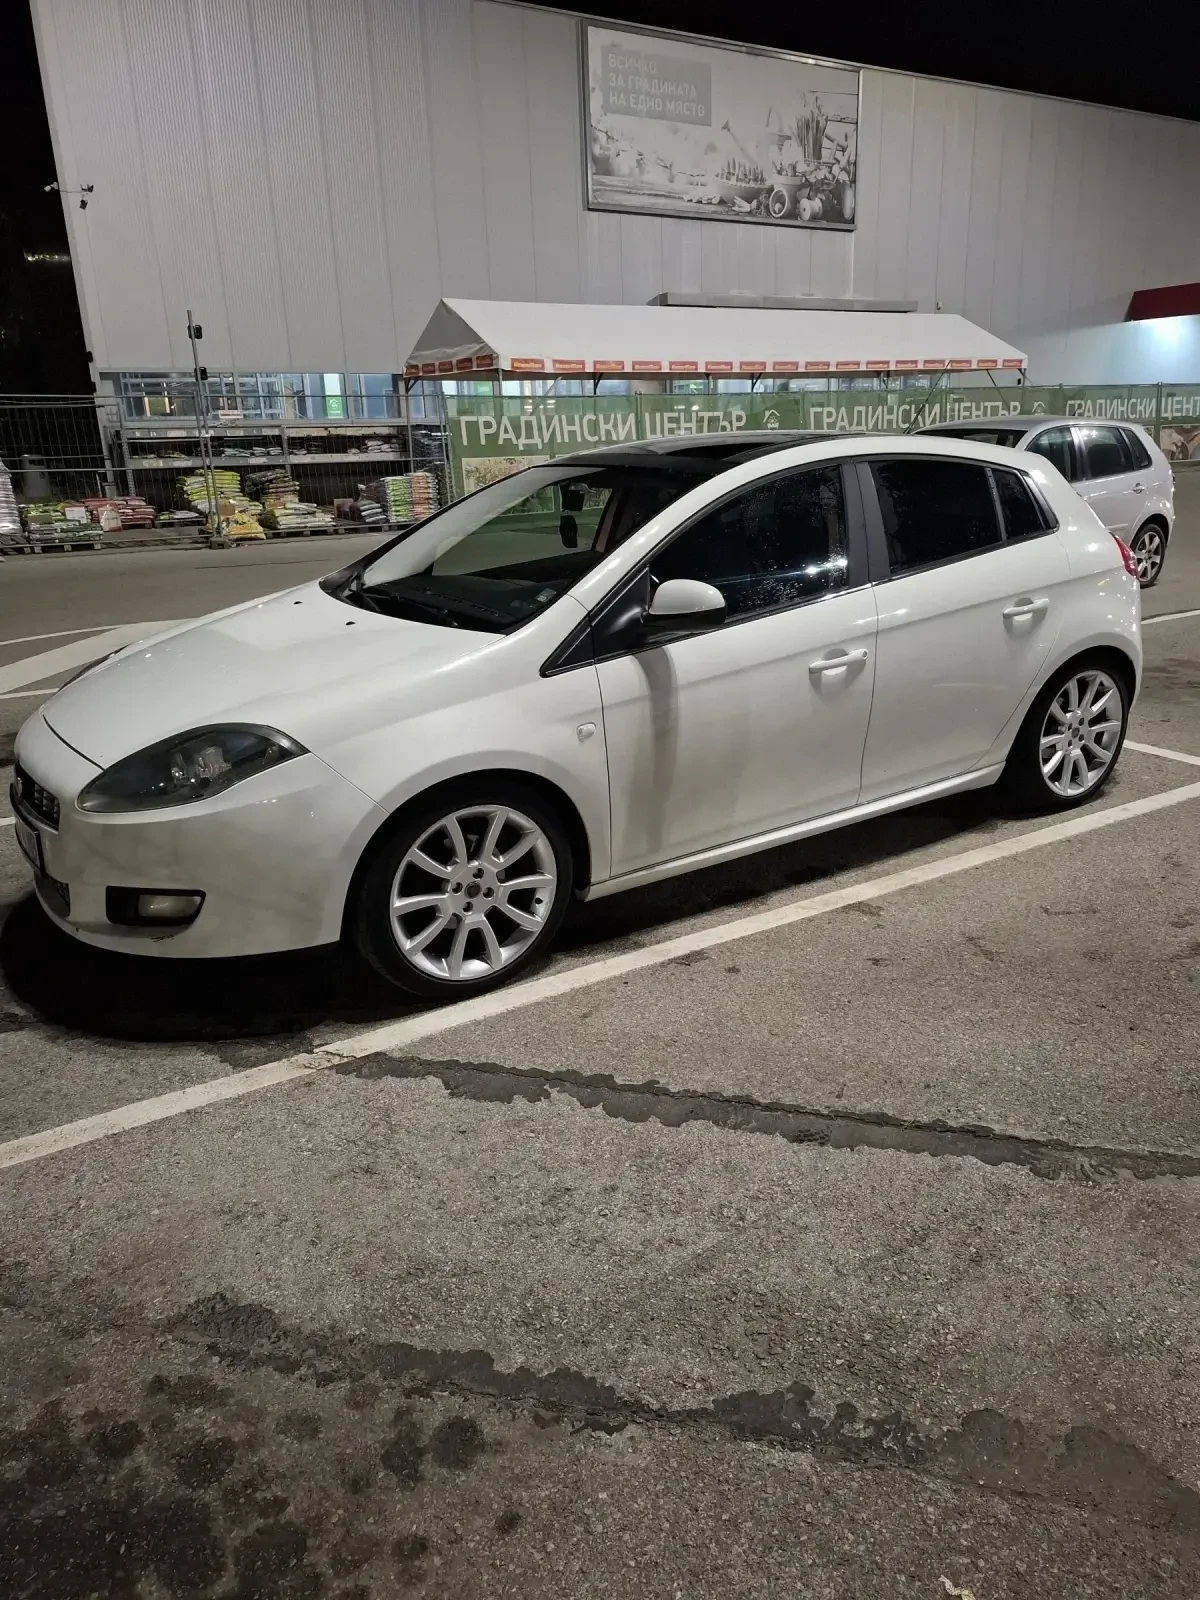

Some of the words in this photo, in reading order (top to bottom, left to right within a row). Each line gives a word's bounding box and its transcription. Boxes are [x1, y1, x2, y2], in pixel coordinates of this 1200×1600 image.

[609, 54, 656, 73] ВСИЧКО
[609, 73, 625, 87] ЗА
[628, 75, 697, 97] ГРАДИНАТА
[610, 91, 627, 106] НА
[630, 95, 663, 111] ЕДНО
[666, 100, 705, 116] МЯСТО
[810, 403, 941, 431] ГРАДИНСКИ
[1066, 398, 1157, 419] ГРАДИНСКИ
[460, 412, 637, 451] ГРАДИНСКИ
[645, 411, 747, 440] ЦЕНТЪР
